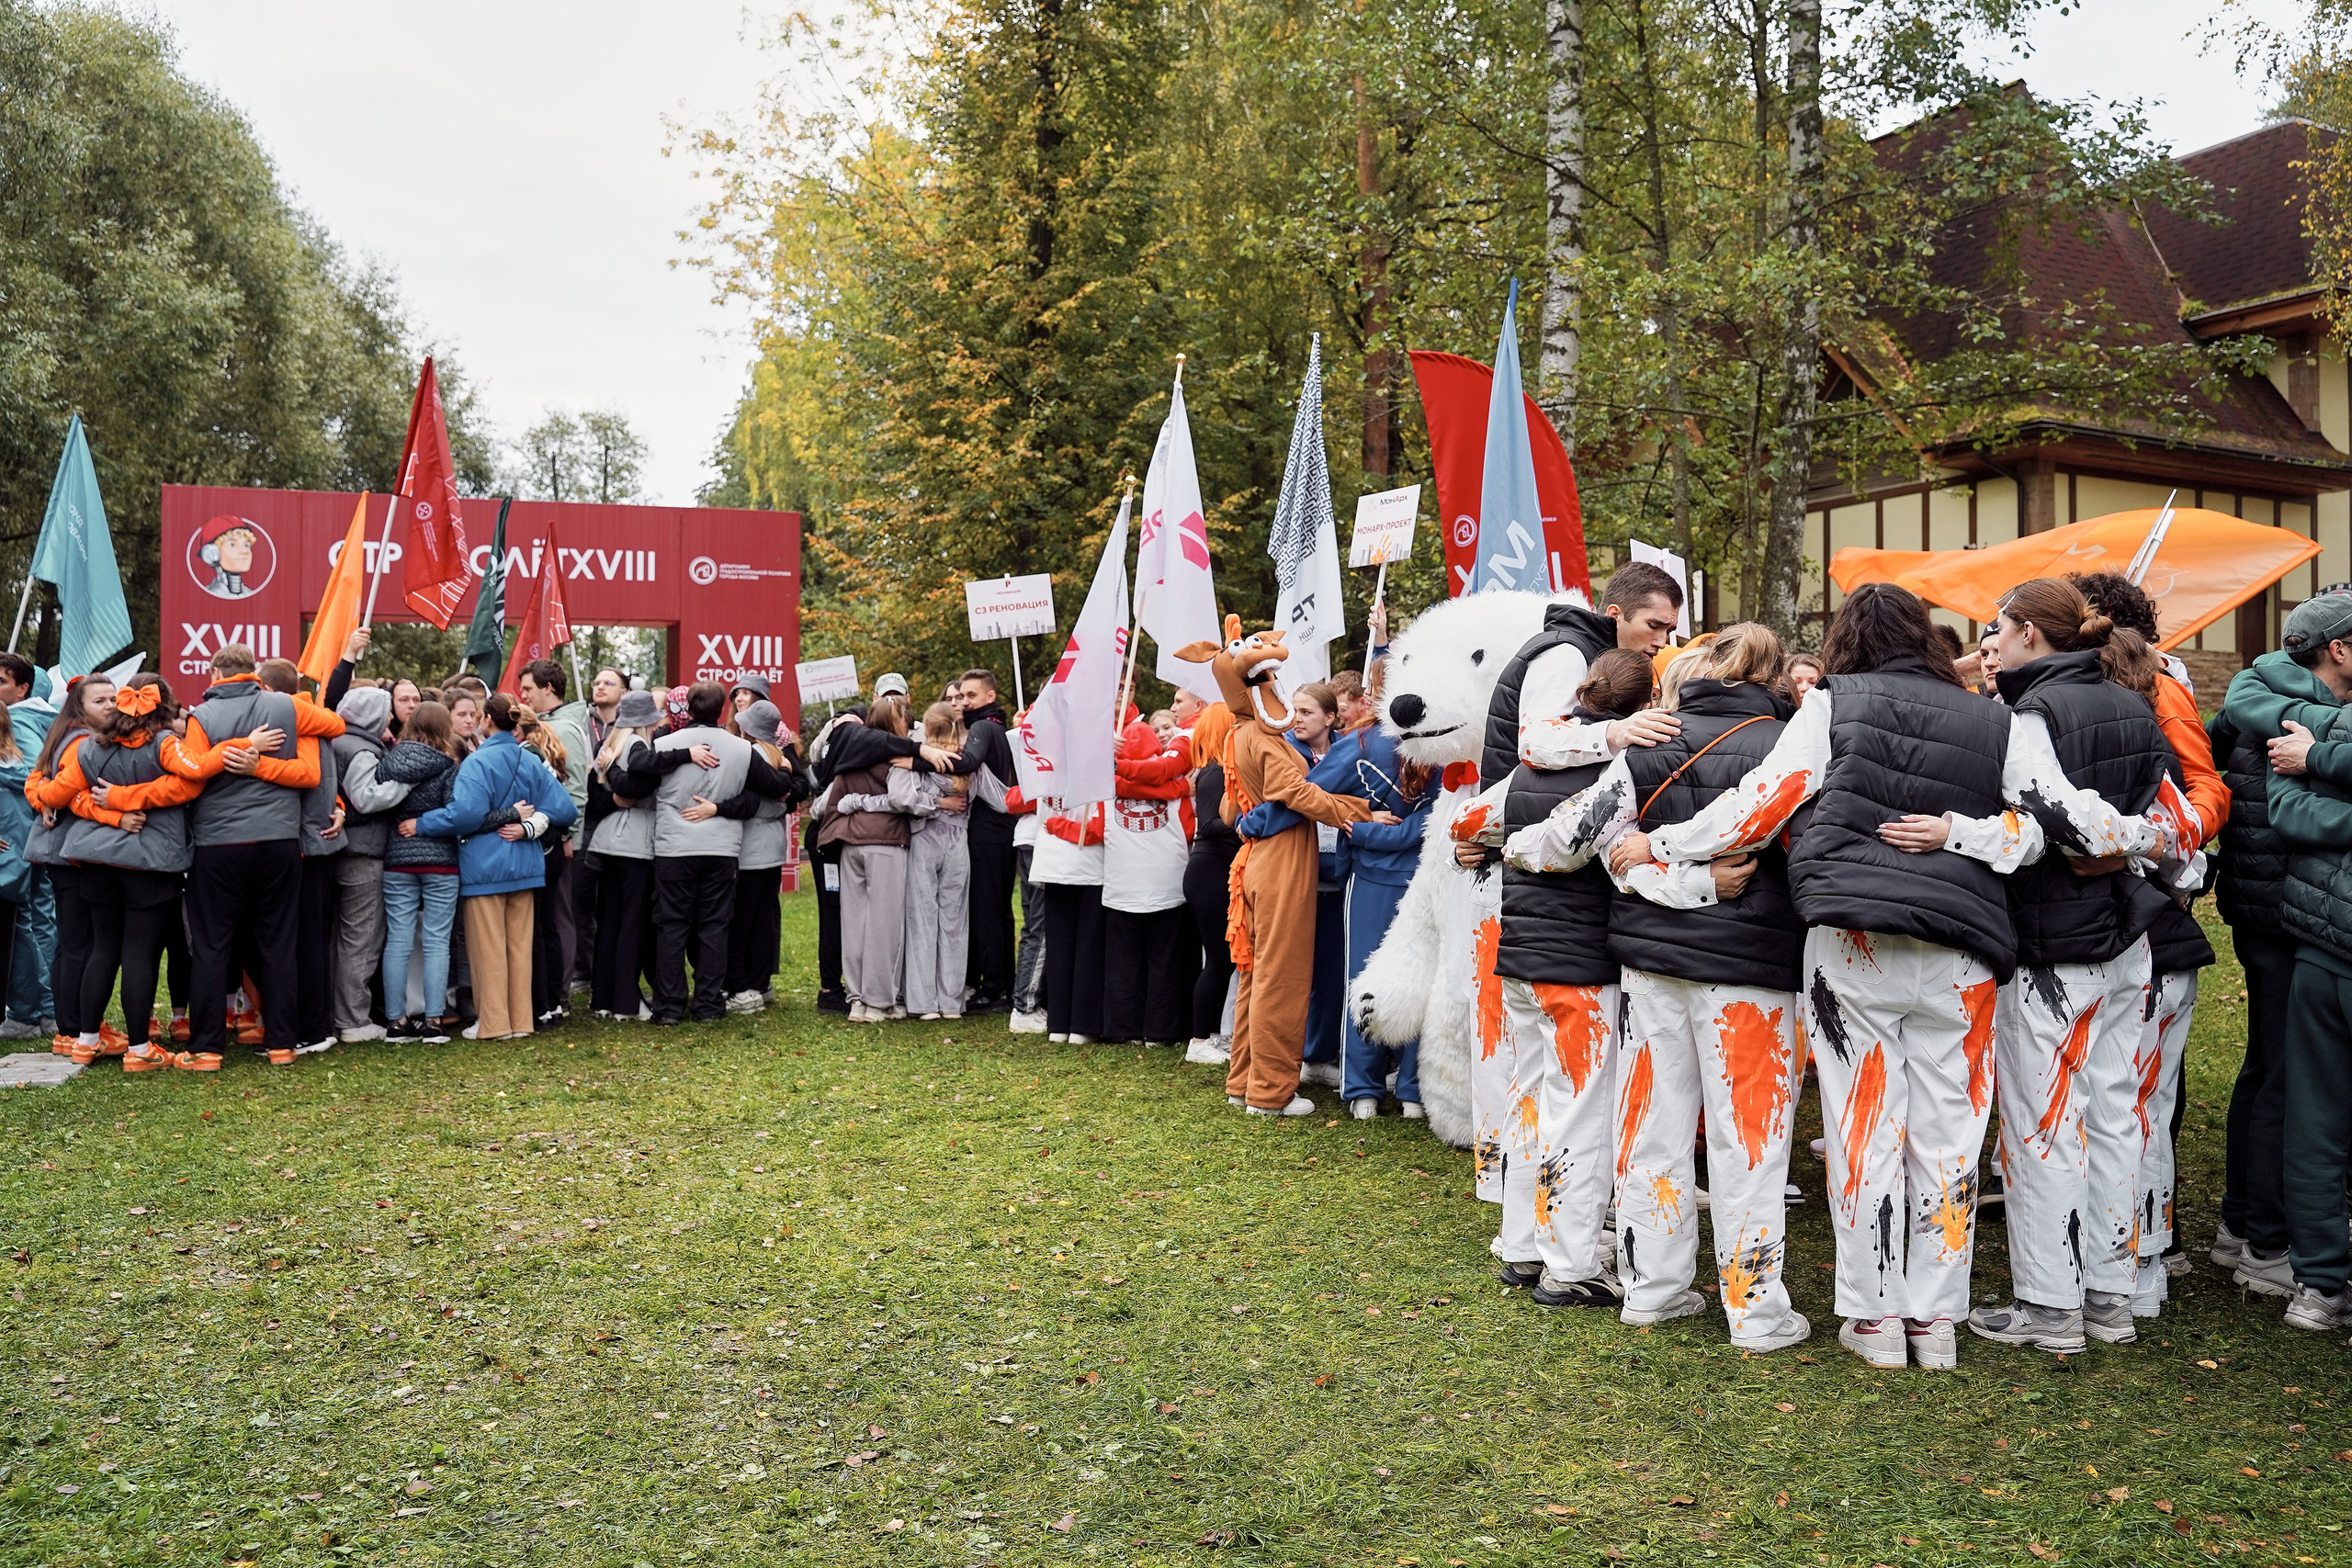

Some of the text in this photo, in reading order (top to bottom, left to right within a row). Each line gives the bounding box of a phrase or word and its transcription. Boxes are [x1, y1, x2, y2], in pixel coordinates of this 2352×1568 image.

[1356, 518, 1412, 536] МОНАРХ-ПРОЕКТ
[989, 600, 1048, 613] РЕНОВАЦИЯ
[180, 622, 281, 659] XVIII
[696, 634, 783, 667] XVIII
